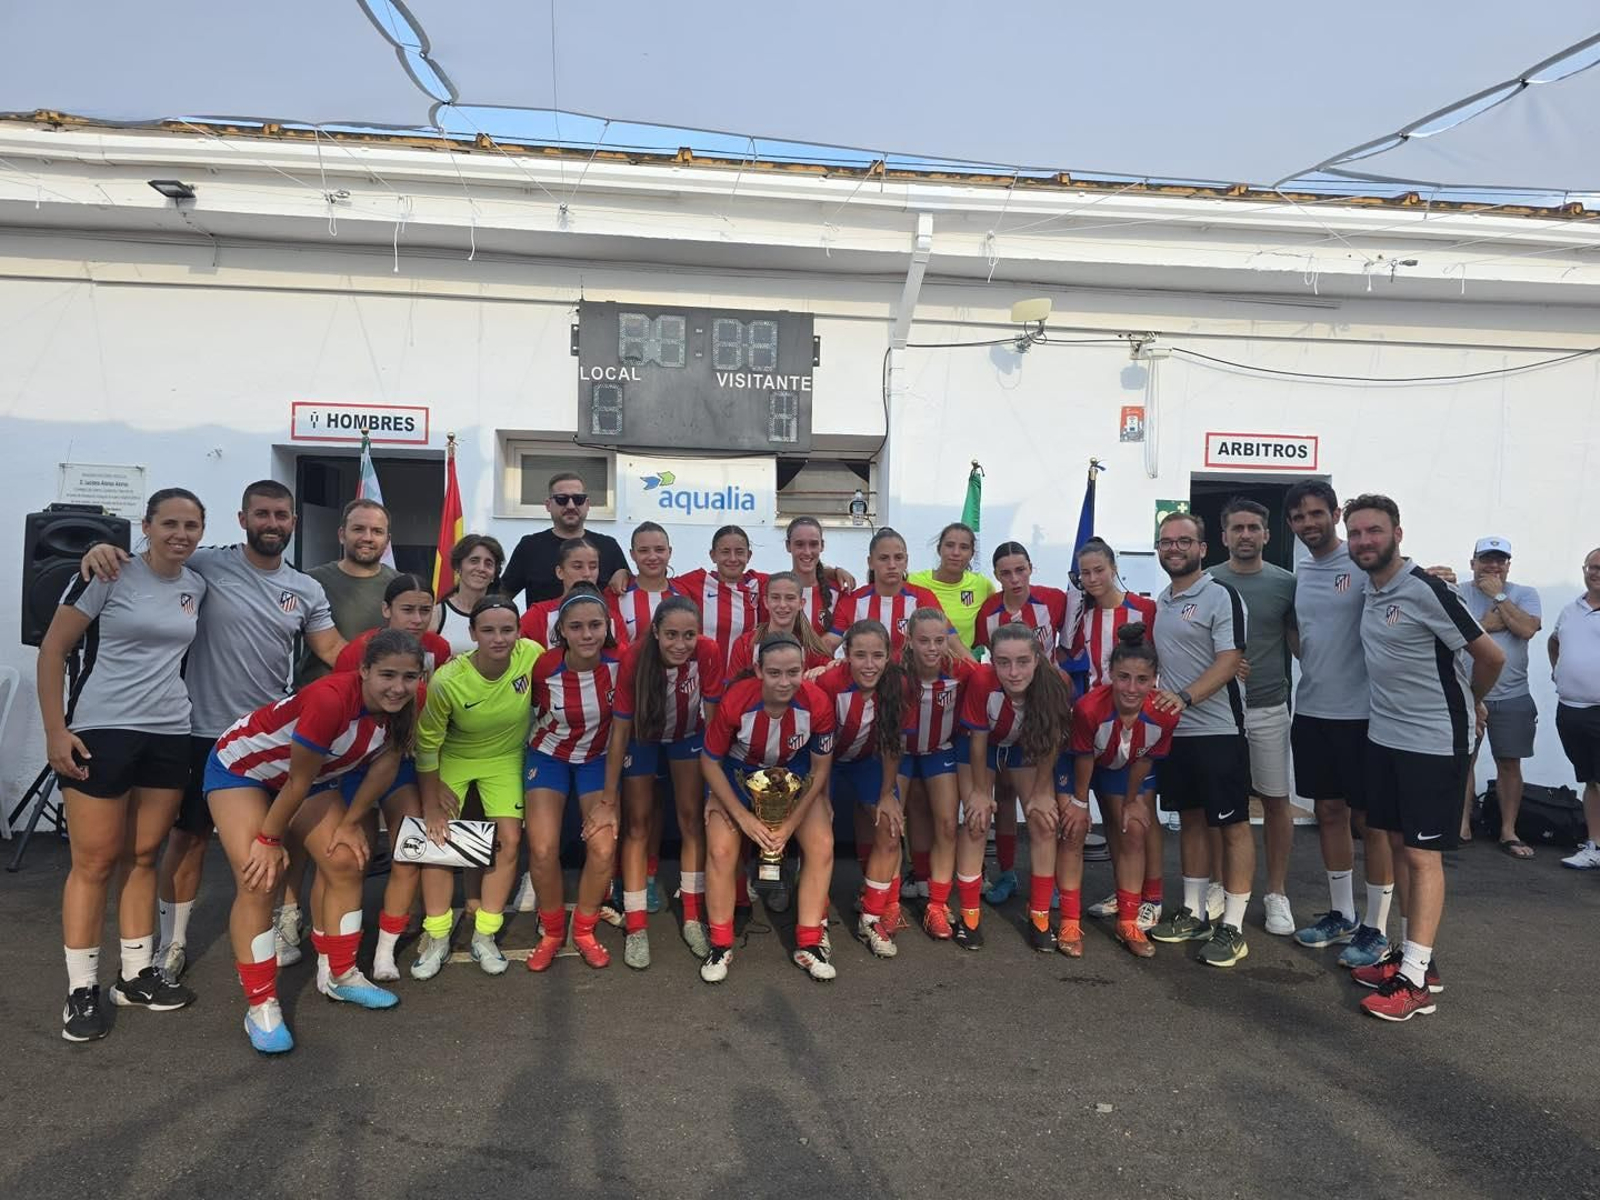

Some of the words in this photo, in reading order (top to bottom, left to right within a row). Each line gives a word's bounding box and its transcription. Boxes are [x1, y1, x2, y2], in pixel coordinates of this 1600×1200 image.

[580, 366, 641, 381] LOCAL
[716, 372, 811, 391] VISITANTE
[327, 413, 415, 432] HOMBRES
[1218, 441, 1308, 459] ARBITROS
[659, 485, 755, 515] aqualia
